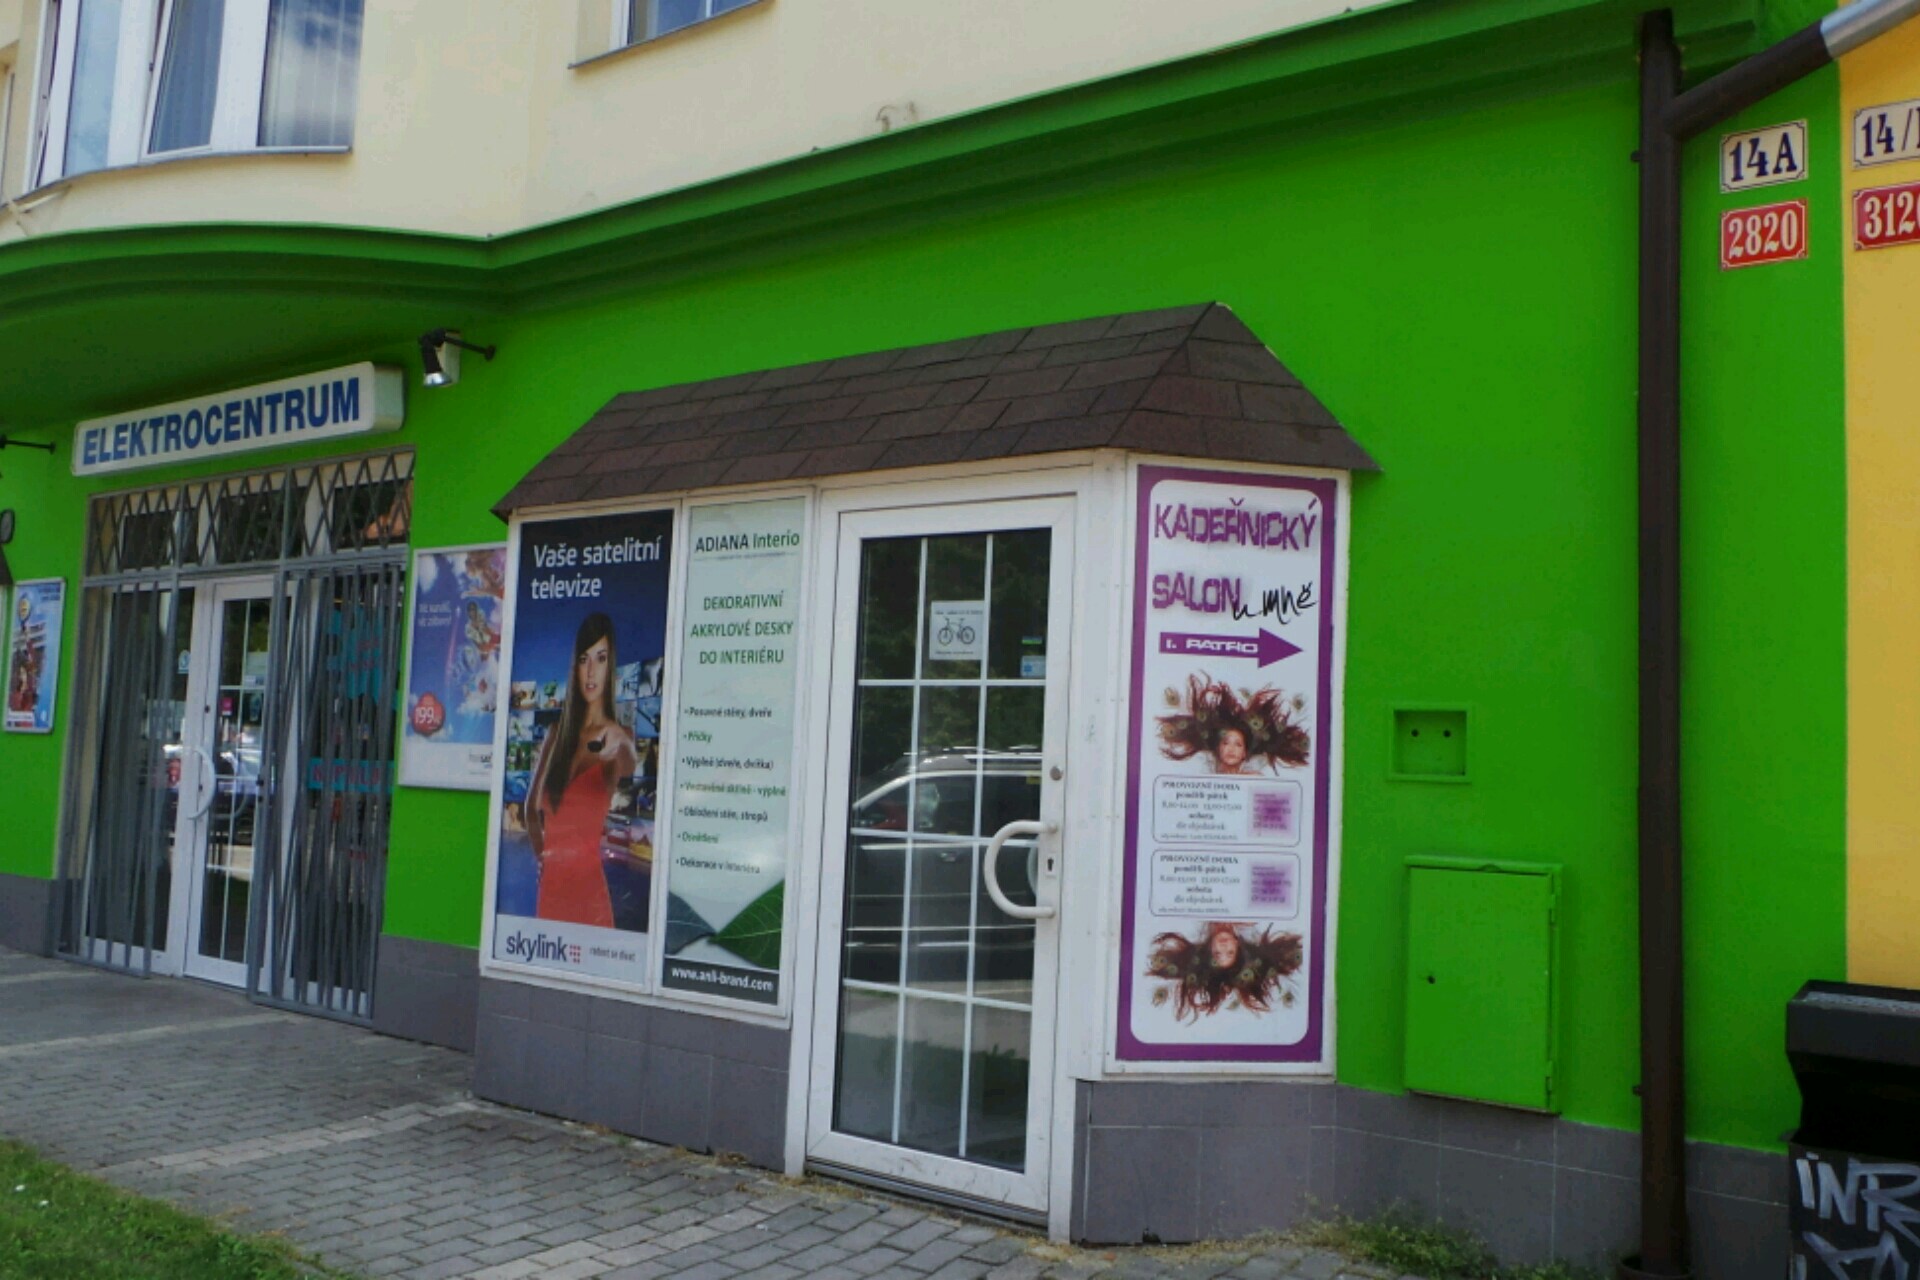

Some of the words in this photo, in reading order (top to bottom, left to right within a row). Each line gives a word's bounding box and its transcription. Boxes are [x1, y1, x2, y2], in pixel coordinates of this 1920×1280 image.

[1729, 132, 1797, 182] 14A
[1728, 209, 1798, 260] 2820
[83, 377, 360, 465] ELEKTROCENTRUM
[1154, 497, 1317, 550] KADEŘNICKÝ
[534, 542, 577, 568] Vaše
[583, 535, 663, 565] satelitní
[695, 533, 749, 554] ADIANA
[752, 529, 800, 550] Interio
[530, 572, 602, 600] televize
[703, 590, 784, 611] DEKORATIVNÍ
[1152, 572, 1241, 613] SALON
[690, 619, 751, 638] AKRYLOVÉ
[754, 621, 793, 636] DESKY
[699, 651, 717, 665] DO
[720, 646, 785, 665] INTERIÉRU
[506, 930, 568, 962] skylink
